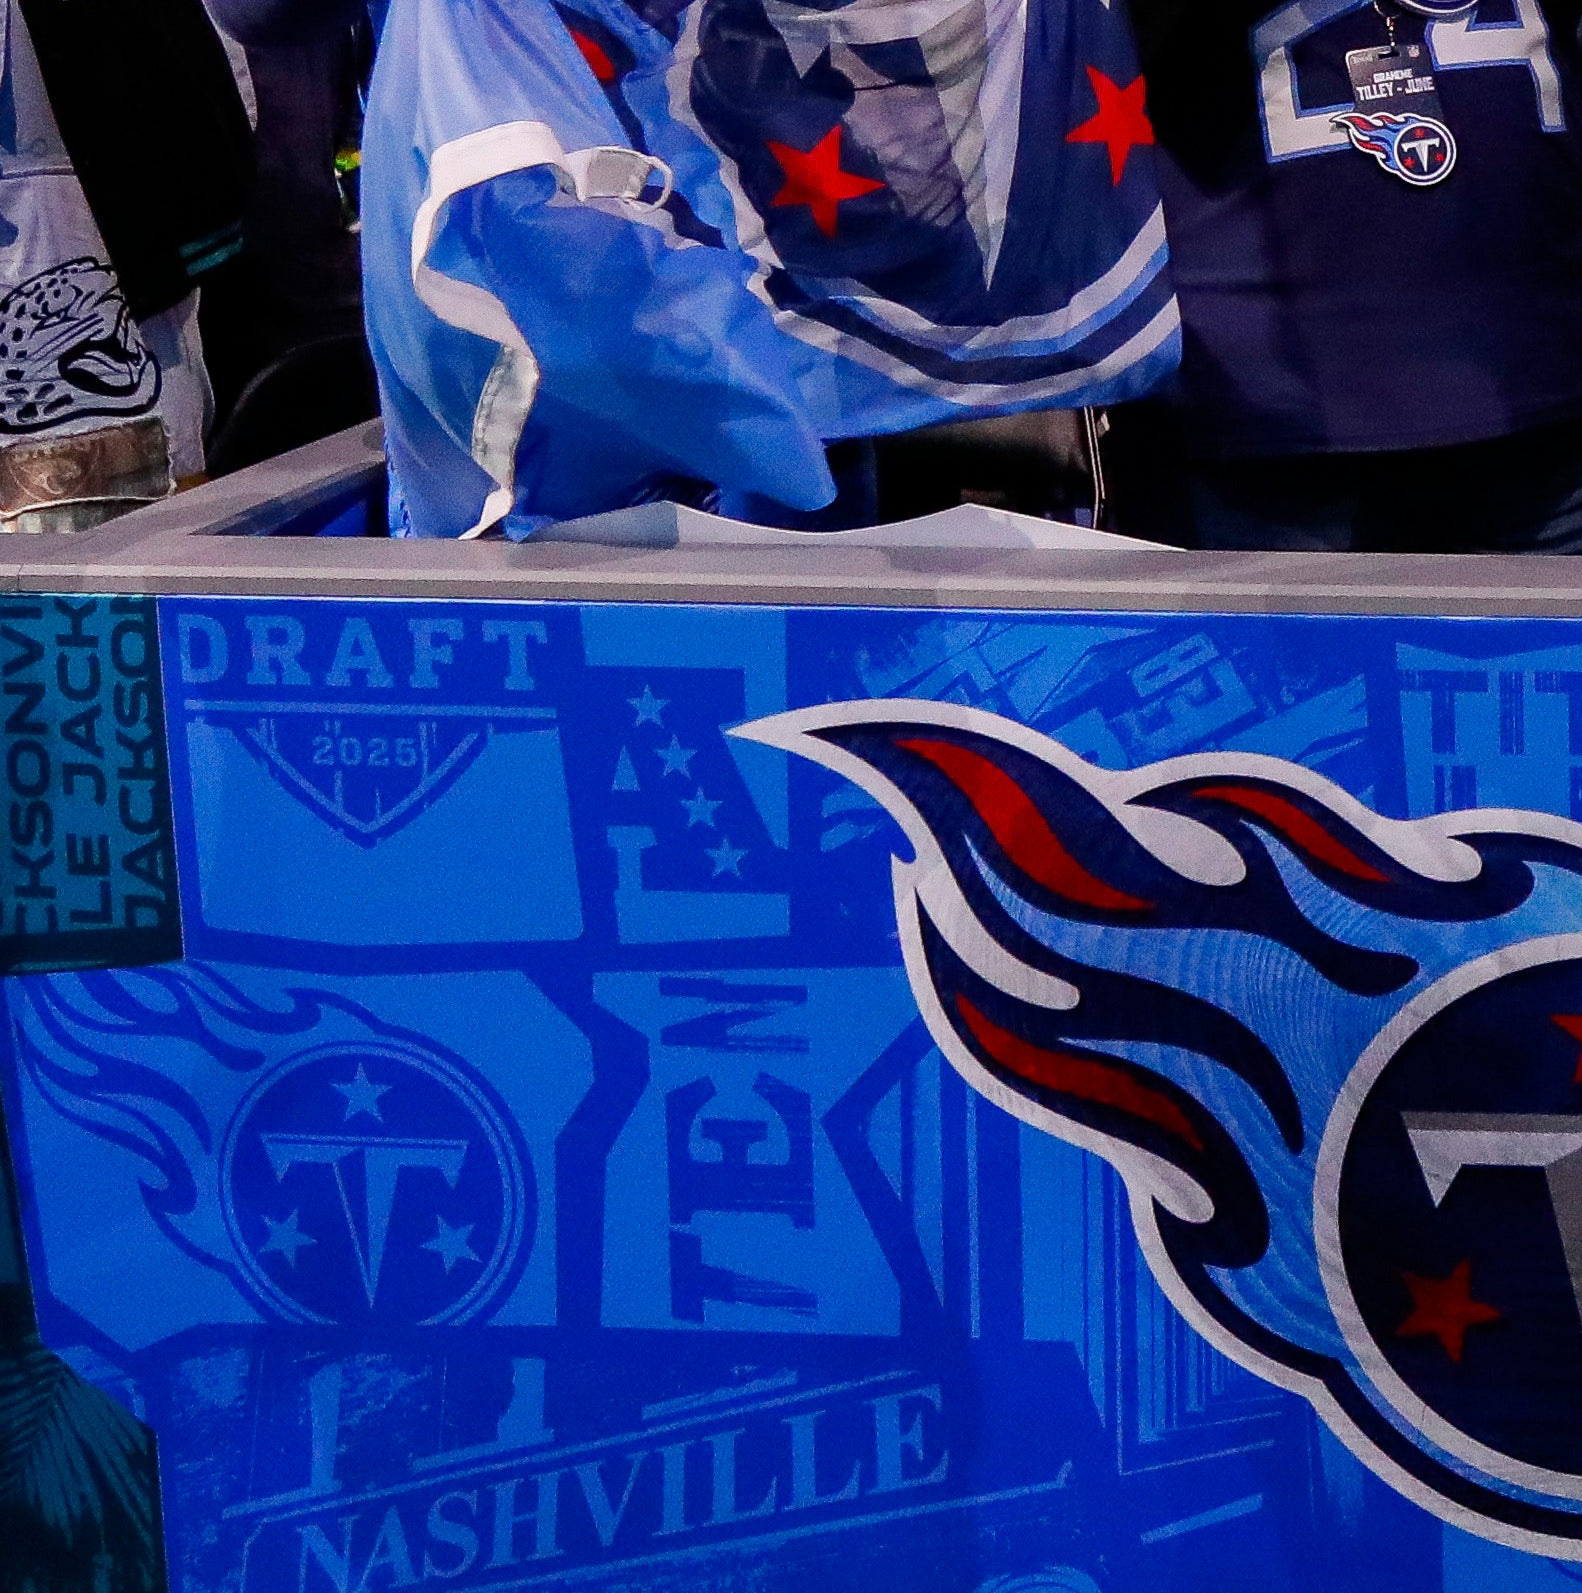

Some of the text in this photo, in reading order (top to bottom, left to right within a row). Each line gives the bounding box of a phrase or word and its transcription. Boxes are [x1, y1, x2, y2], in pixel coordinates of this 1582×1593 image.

[54, 599, 108, 807] JACK
[177, 613, 550, 692] DRAFT
[311, 735, 418, 768] 2025
[298, 1385, 949, 1593] NASHVILLE
